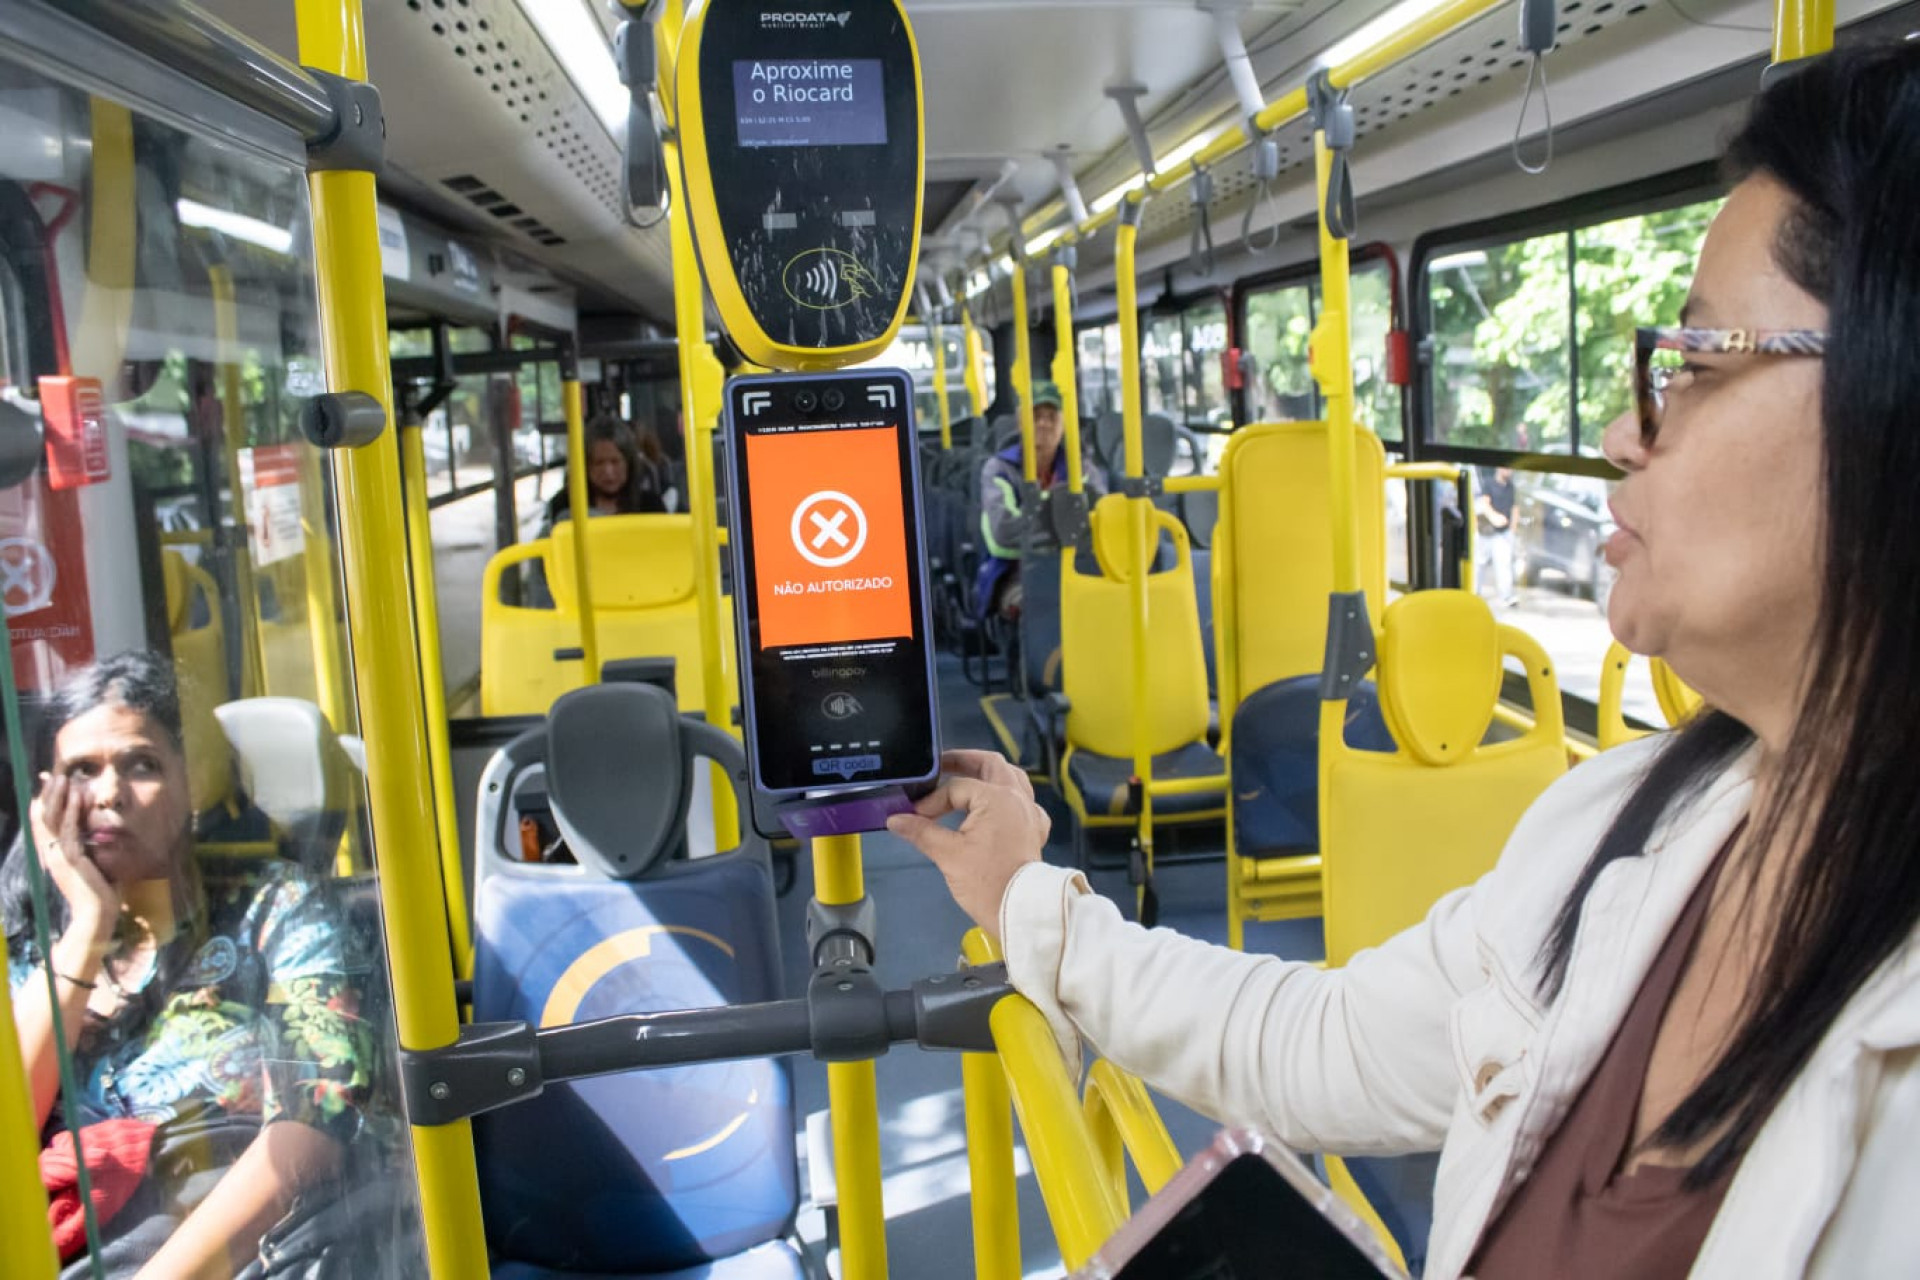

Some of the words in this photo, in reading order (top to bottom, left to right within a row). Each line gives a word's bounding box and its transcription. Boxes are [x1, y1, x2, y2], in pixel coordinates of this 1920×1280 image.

[761, 13, 836, 22] PRODATA
[750, 60, 853, 84] Aproxime
[753, 88, 766, 103] o
[773, 83, 854, 102] Riocard
[774, 582, 804, 595] NÃO
[807, 576, 893, 593] AUTORIZADO
[819, 760, 840, 772] QR
